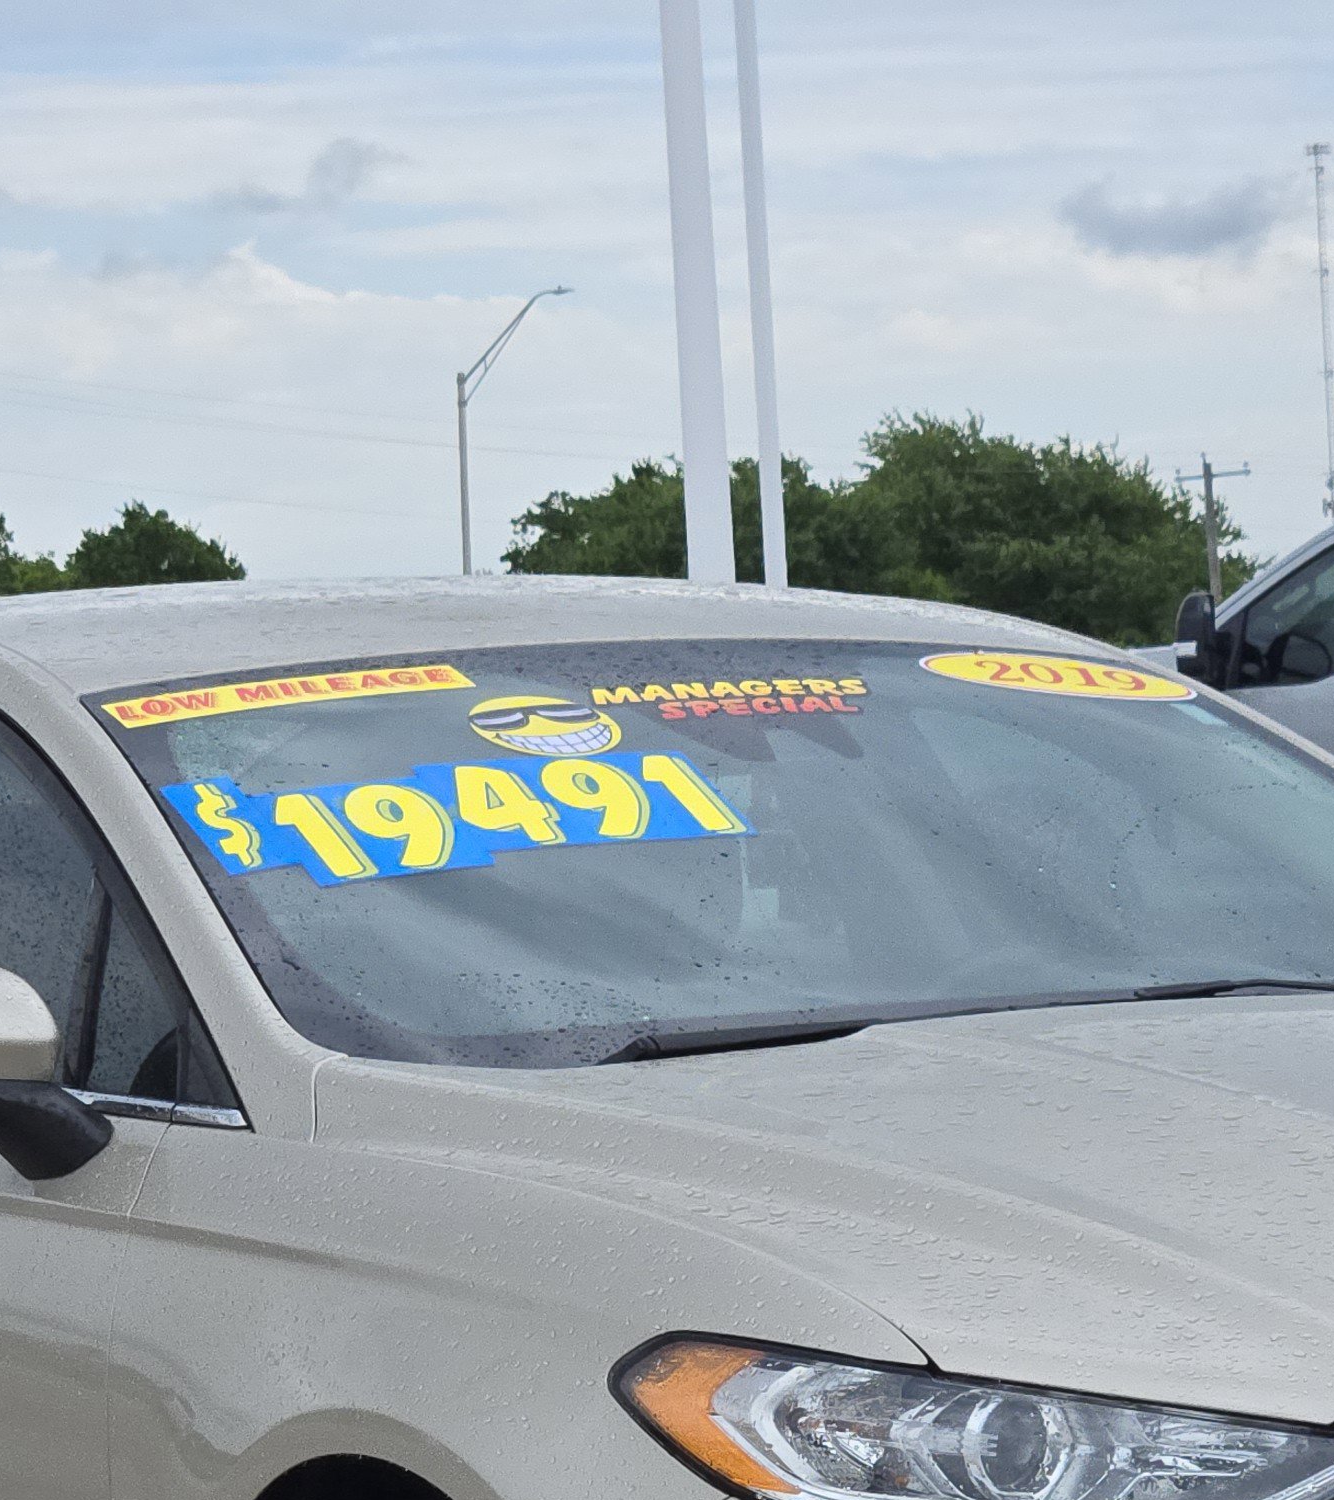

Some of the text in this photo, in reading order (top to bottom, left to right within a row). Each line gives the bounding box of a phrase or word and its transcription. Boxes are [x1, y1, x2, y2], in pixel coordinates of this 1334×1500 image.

[973, 660, 1147, 691] 2019
[114, 667, 454, 720] LOW MILEAGE
[591, 677, 868, 705] MANAGERS
[657, 695, 861, 720] SPECIAL
